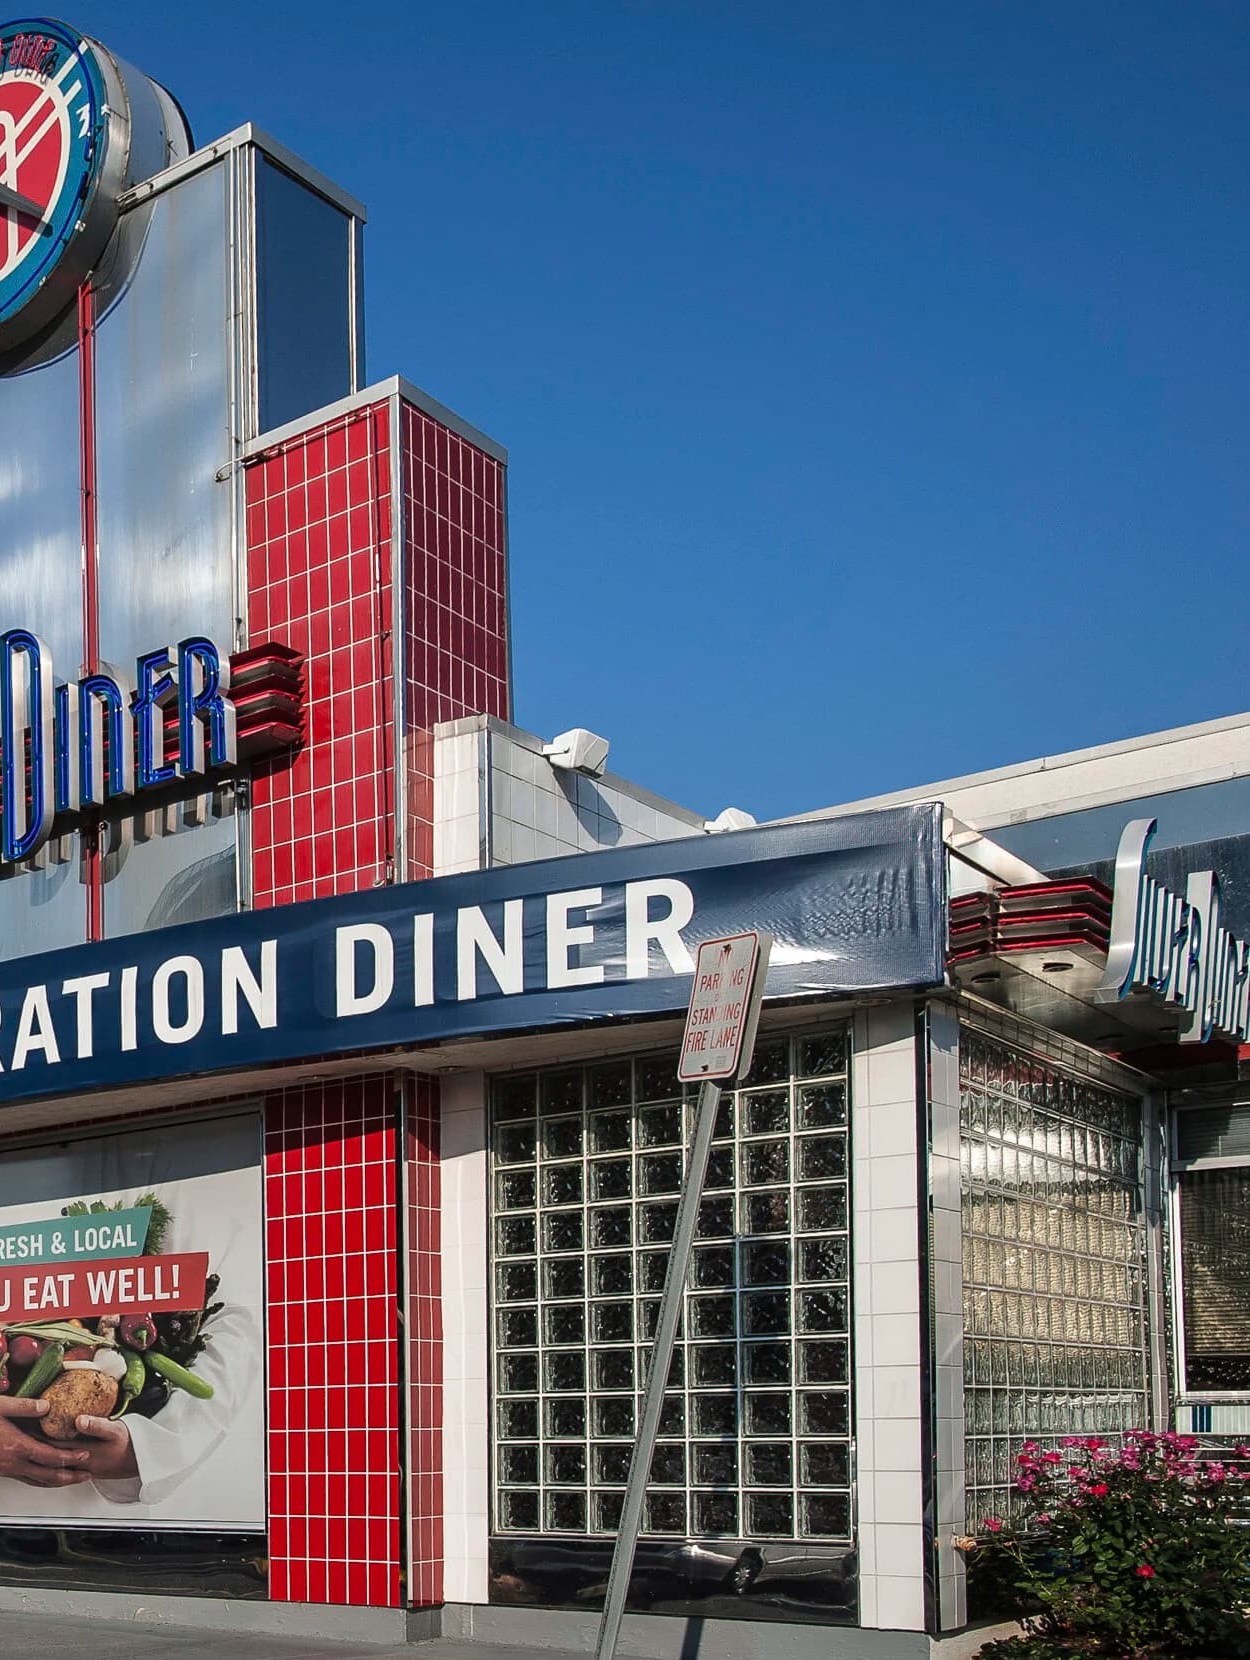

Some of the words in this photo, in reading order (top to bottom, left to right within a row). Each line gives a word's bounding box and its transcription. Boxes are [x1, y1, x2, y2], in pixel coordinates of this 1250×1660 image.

[0, 628, 238, 863] DINER
[335, 877, 697, 1019] DINER
[686, 1030, 708, 1053] FIRE
[51, 1231, 66, 1255] &
[74, 1224, 138, 1252] LOCAL
[23, 1273, 75, 1311] EAT
[86, 1264, 180, 1305] WELL!
